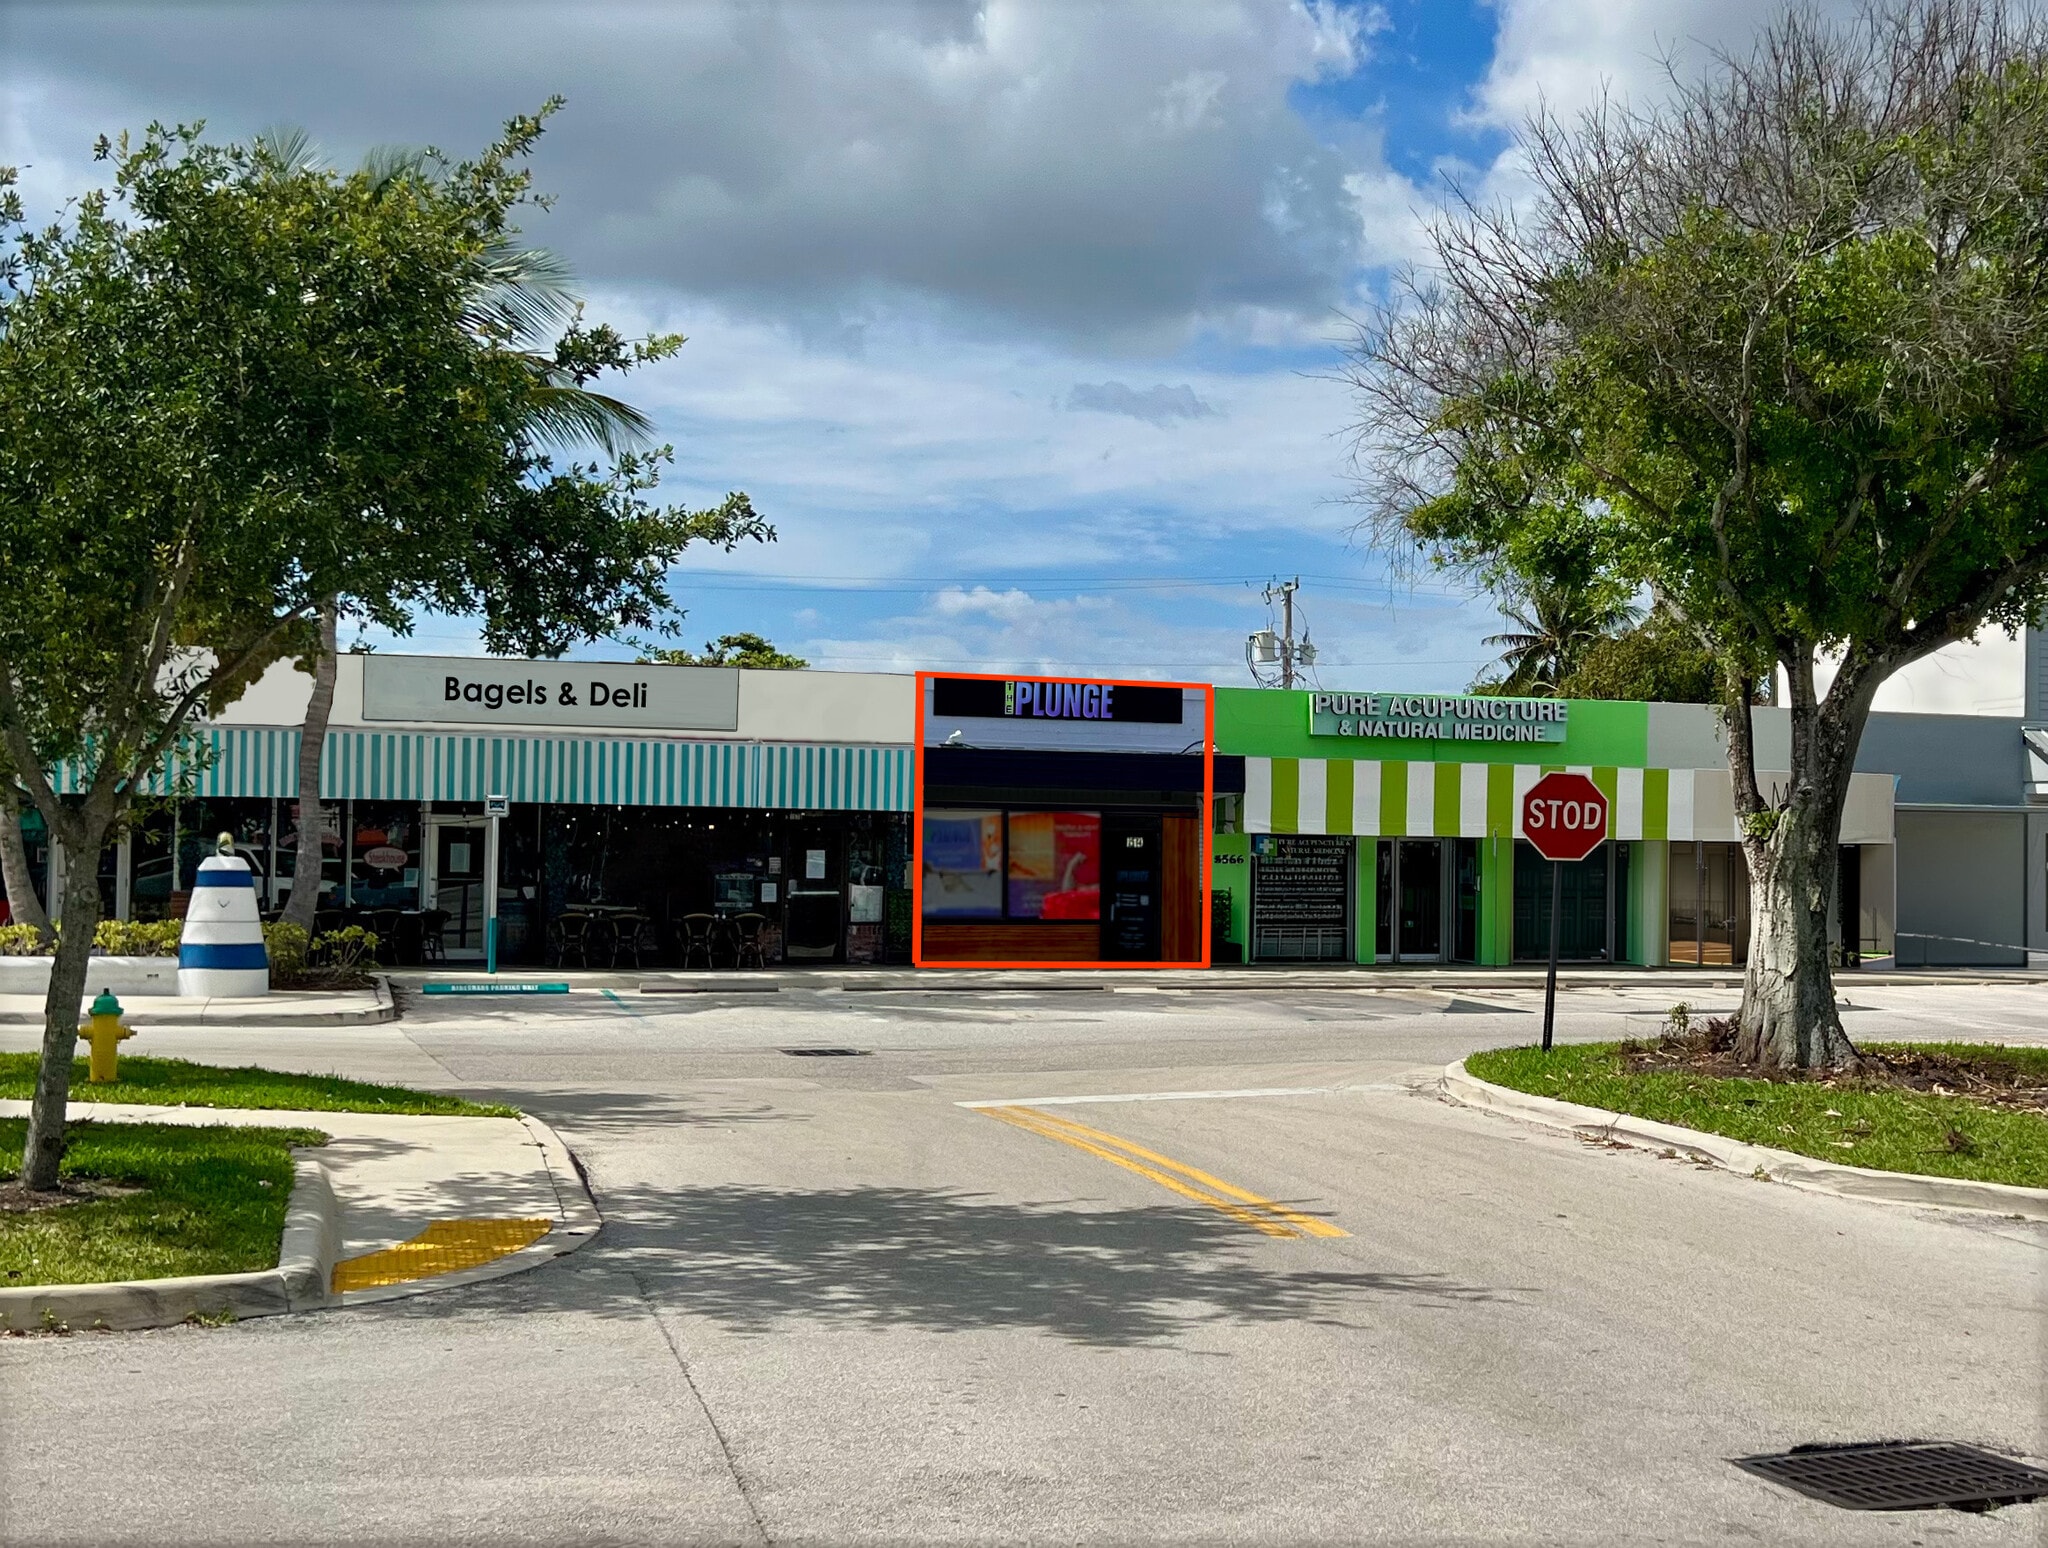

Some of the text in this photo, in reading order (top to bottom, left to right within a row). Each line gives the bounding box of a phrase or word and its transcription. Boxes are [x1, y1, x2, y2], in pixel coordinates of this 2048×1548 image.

[445, 676, 648, 710] Bagels & Deli
[1005, 681, 1114, 718] THE PLUNGE
[1315, 692, 1568, 722] PURE ACUPUNCTURE
[1339, 719, 1546, 742] & NATURAL MEDICINE
